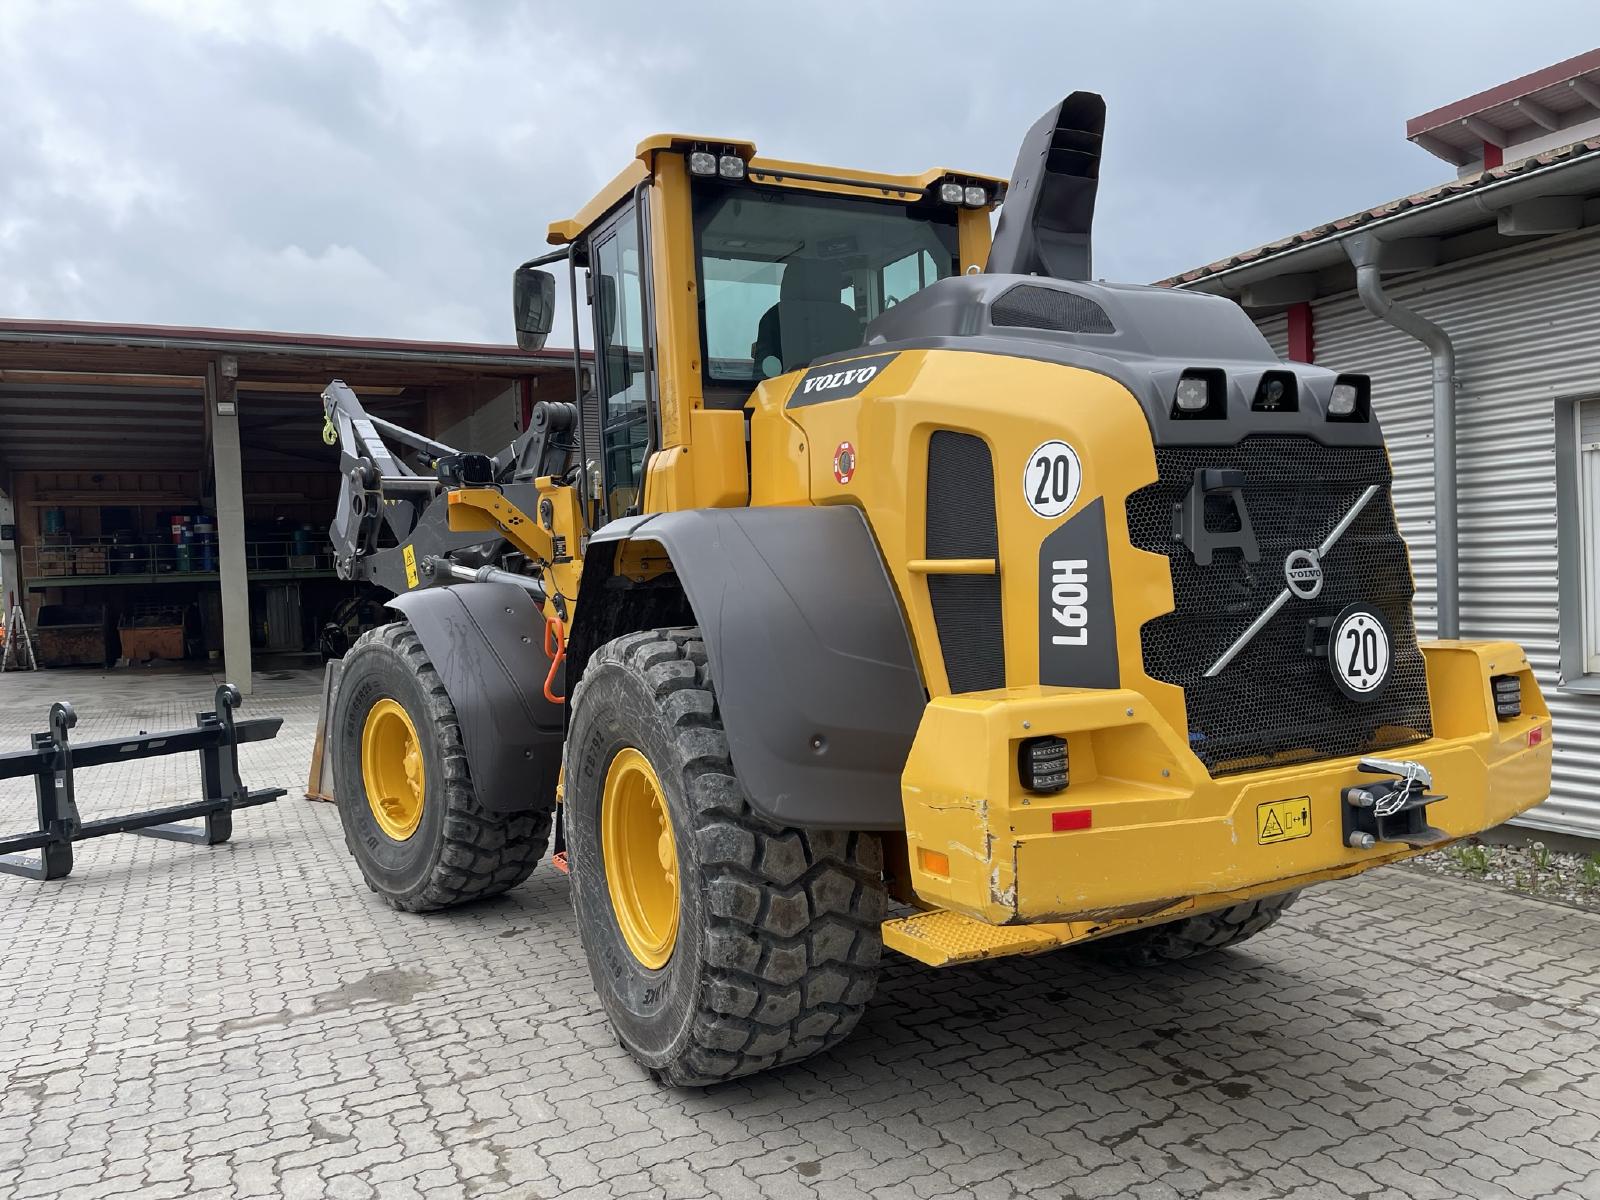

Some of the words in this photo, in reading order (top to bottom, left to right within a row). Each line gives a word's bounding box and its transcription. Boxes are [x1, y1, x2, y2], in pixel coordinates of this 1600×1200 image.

[803, 366, 877, 394] VOLVO
[1034, 454, 1070, 505] 20
[1288, 569, 1321, 578] VOLVO
[1052, 559, 1088, 646] L60H
[1346, 628, 1378, 677] 20
[583, 731, 605, 778] CB792
